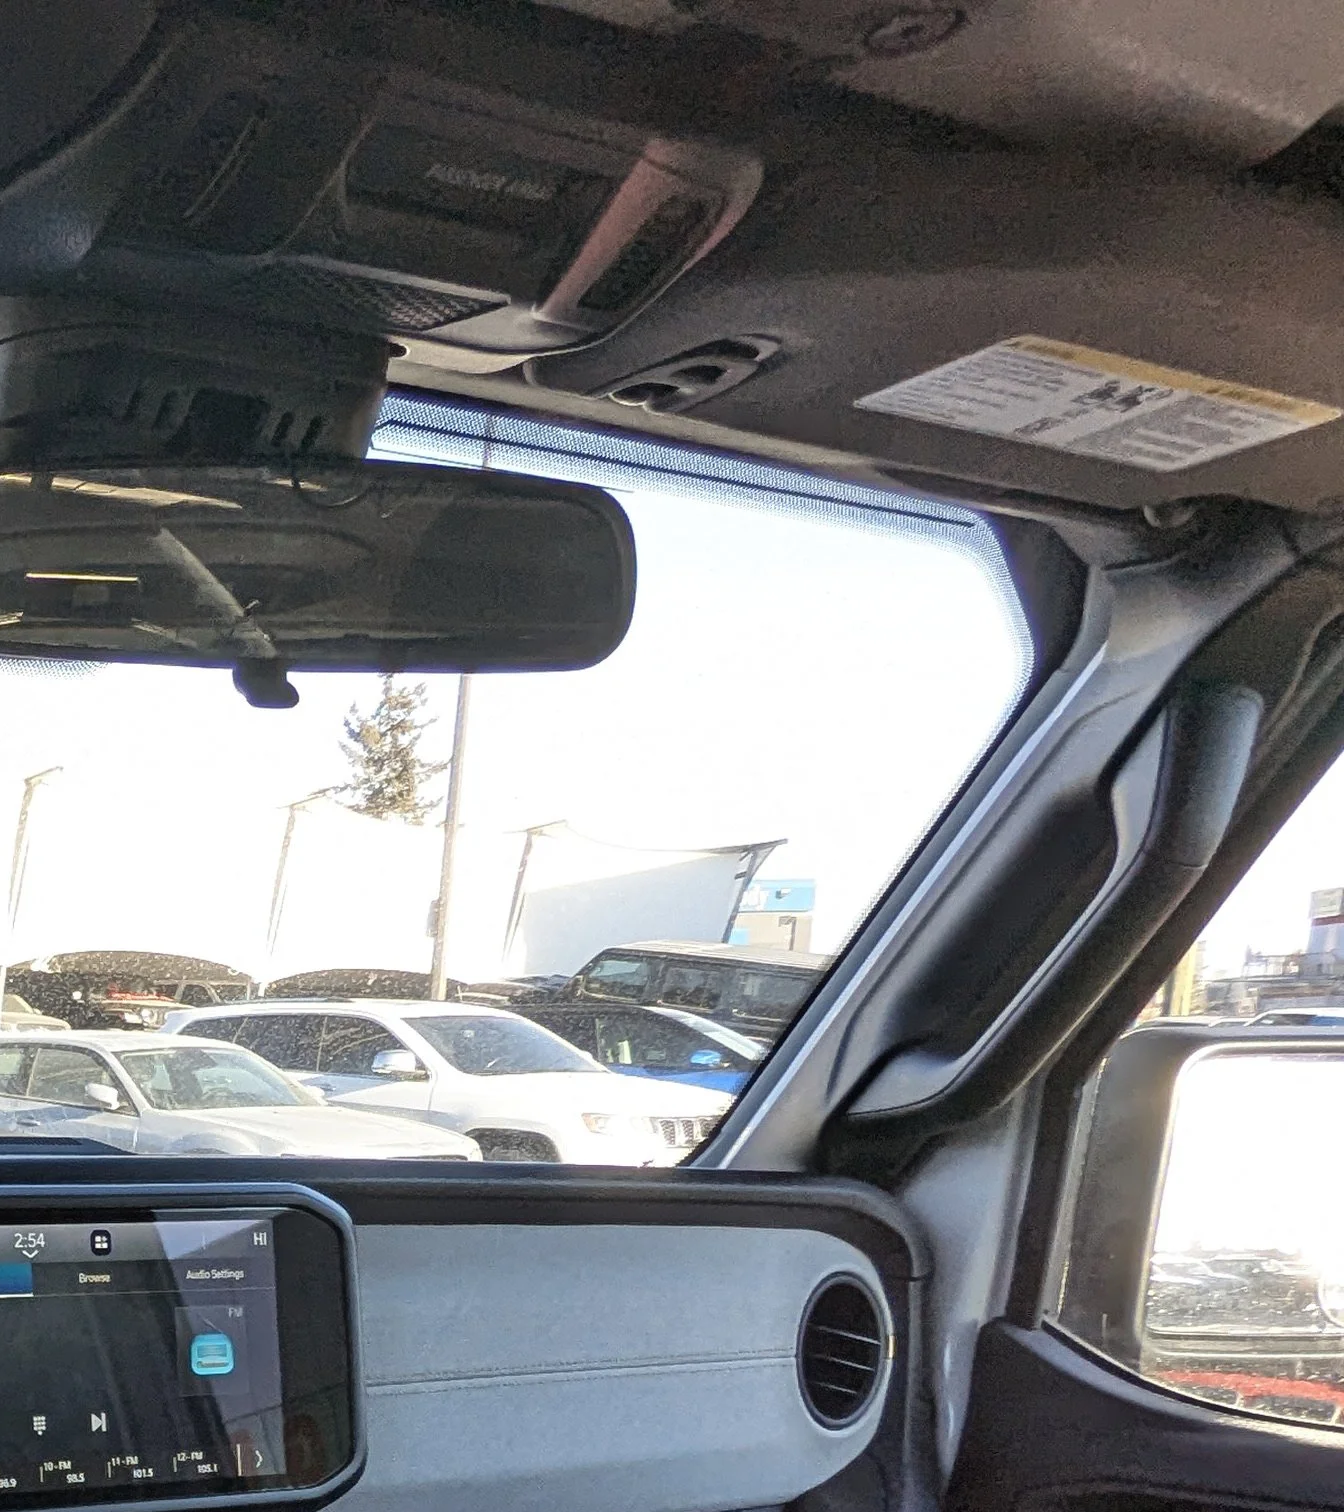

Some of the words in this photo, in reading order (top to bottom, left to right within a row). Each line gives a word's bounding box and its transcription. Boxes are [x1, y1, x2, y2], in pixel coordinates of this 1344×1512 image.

[14, 1232, 46, 1249] 2:54
[253, 1231, 268, 1246] HI
[77, 1272, 111, 1284] Browse
[186, 1269, 211, 1280] Audio
[211, 1269, 245, 1281] Settings
[227, 1307, 244, 1318] FM
